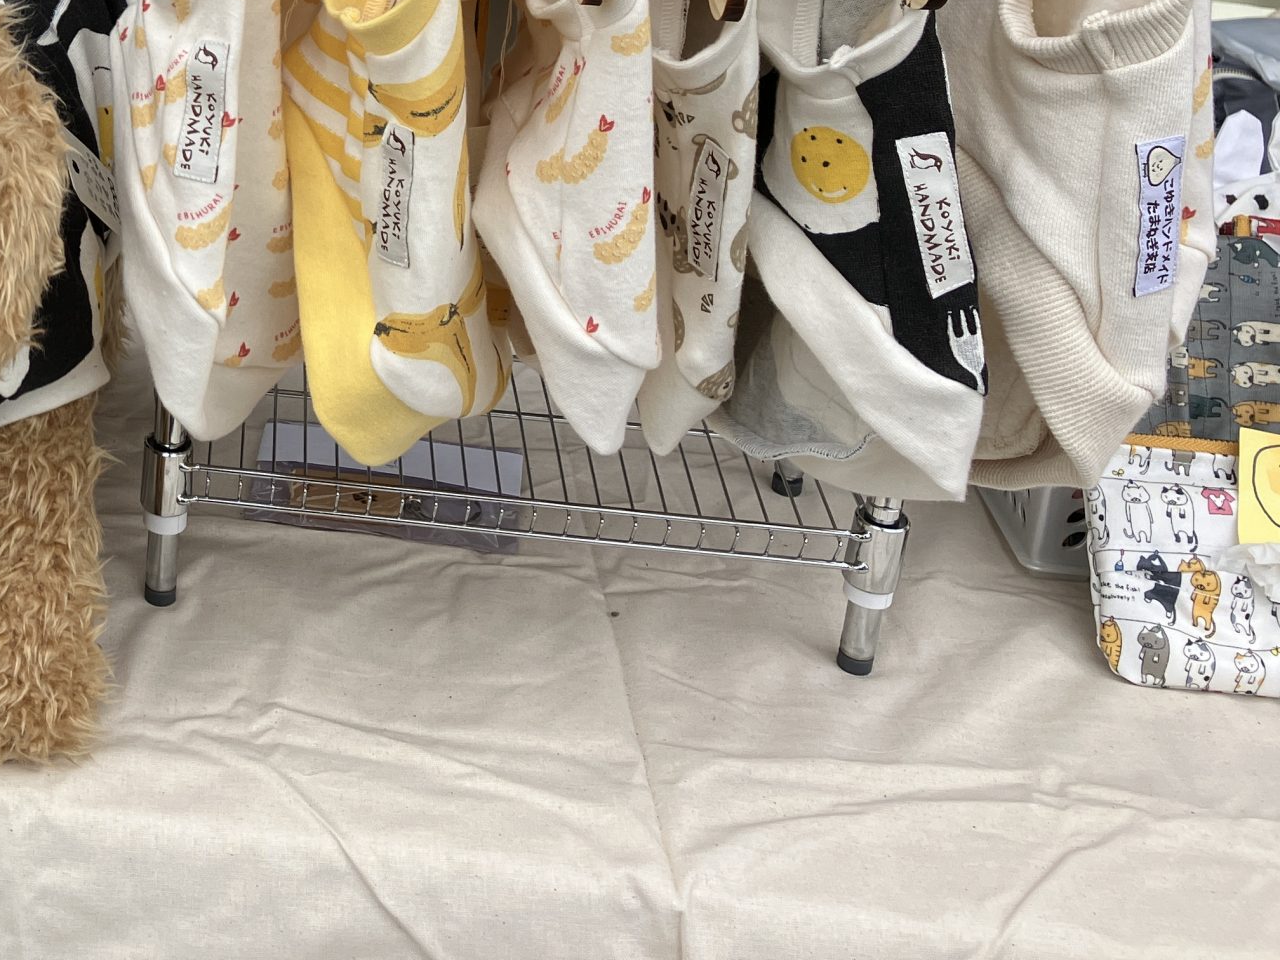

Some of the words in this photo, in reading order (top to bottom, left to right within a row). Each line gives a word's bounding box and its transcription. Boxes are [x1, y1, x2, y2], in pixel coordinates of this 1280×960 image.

[180, 74, 203, 171] HANDMADE
[379, 158, 397, 253] HANDMADE
[690, 177, 709, 268] HANDMADE
[913, 183, 947, 284] HANDMADE
[1156, 178, 1176, 285] こゆきハンドメイド
